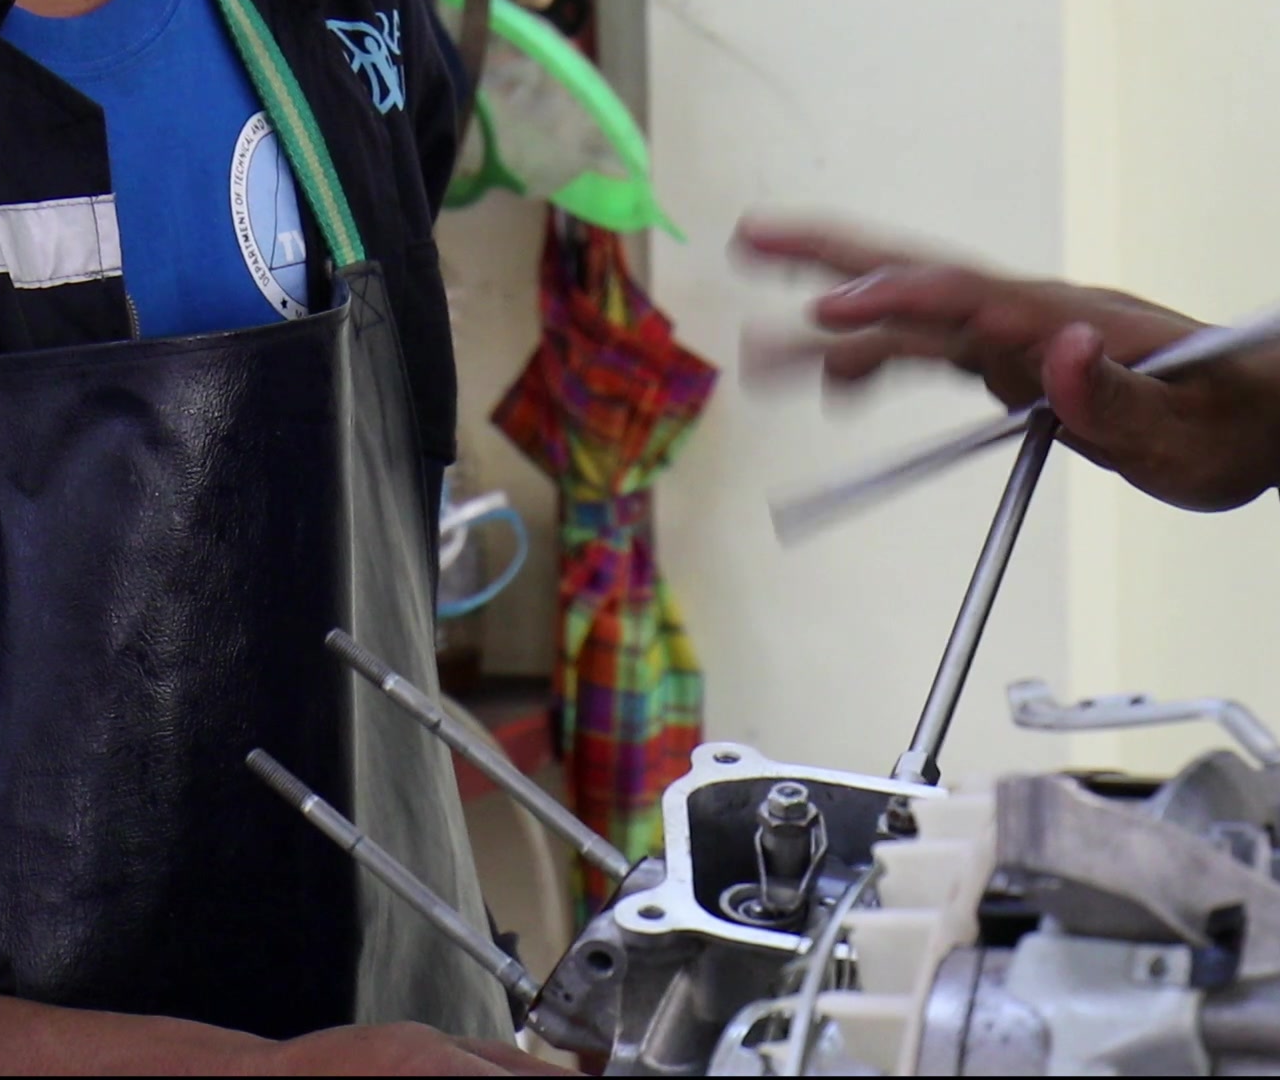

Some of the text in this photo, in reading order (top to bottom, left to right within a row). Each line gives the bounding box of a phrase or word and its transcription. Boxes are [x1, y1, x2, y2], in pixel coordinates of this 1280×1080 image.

[233, 134, 255, 187] TECHNICAL
[234, 191, 244, 207] OF
[235, 208, 271, 288] DEPARTMENT
